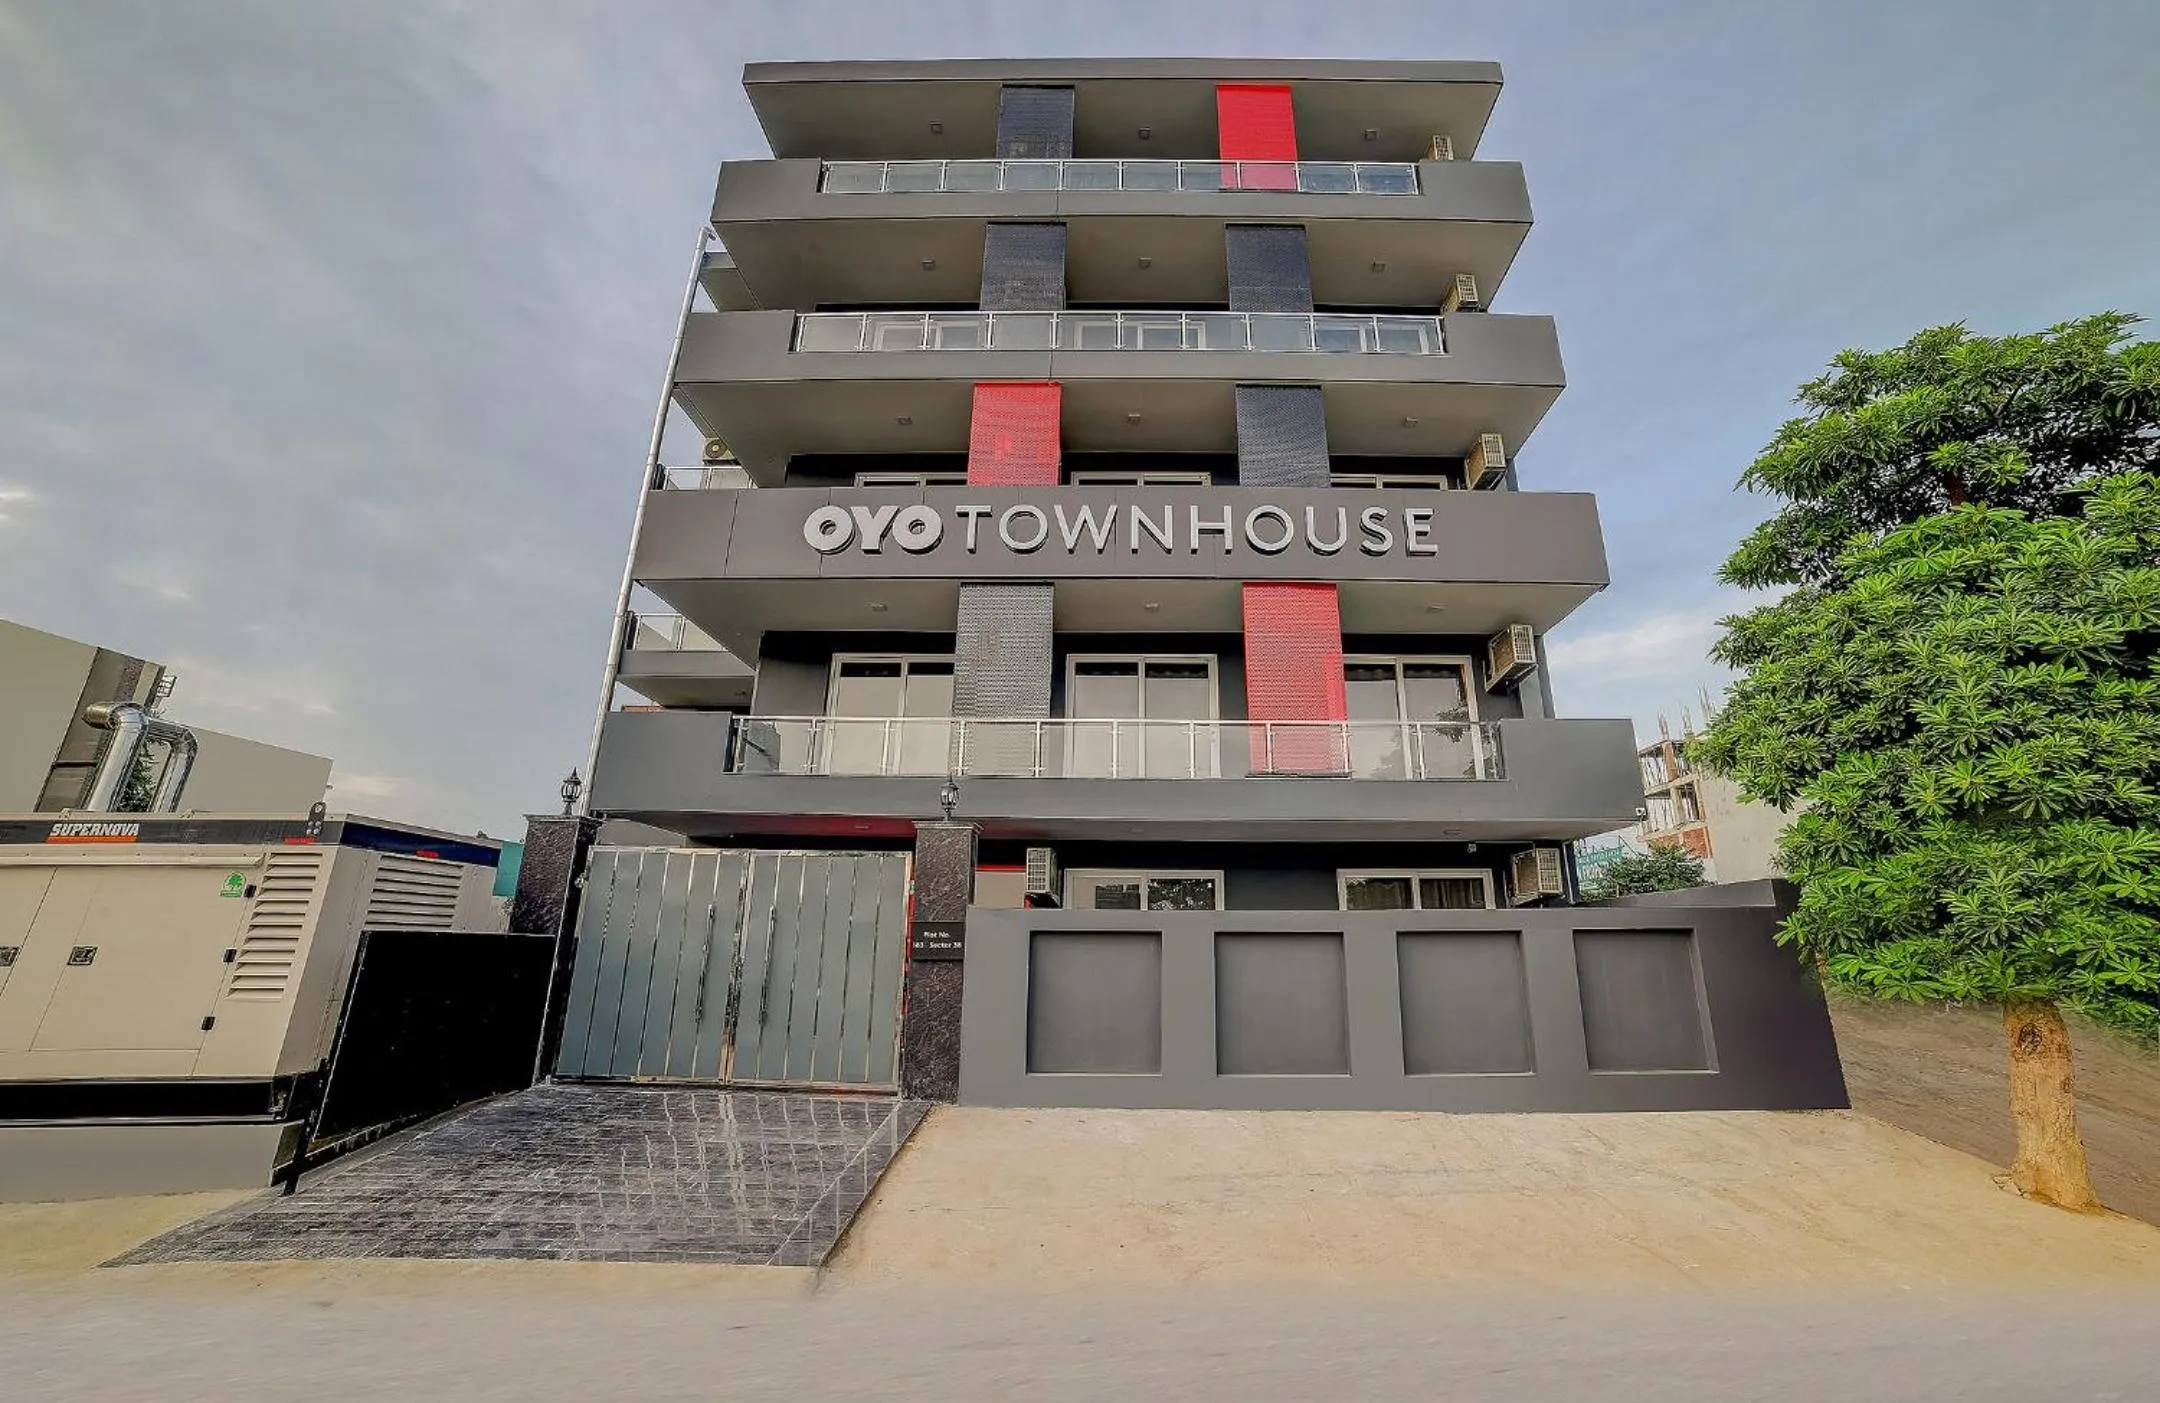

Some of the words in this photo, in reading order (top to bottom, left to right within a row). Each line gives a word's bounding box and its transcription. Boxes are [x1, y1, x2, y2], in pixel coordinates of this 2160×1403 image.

[803, 504, 944, 553] OYO
[955, 504, 1439, 556] TOWNHOUSE
[50, 823, 140, 836] SUPERNOVA
